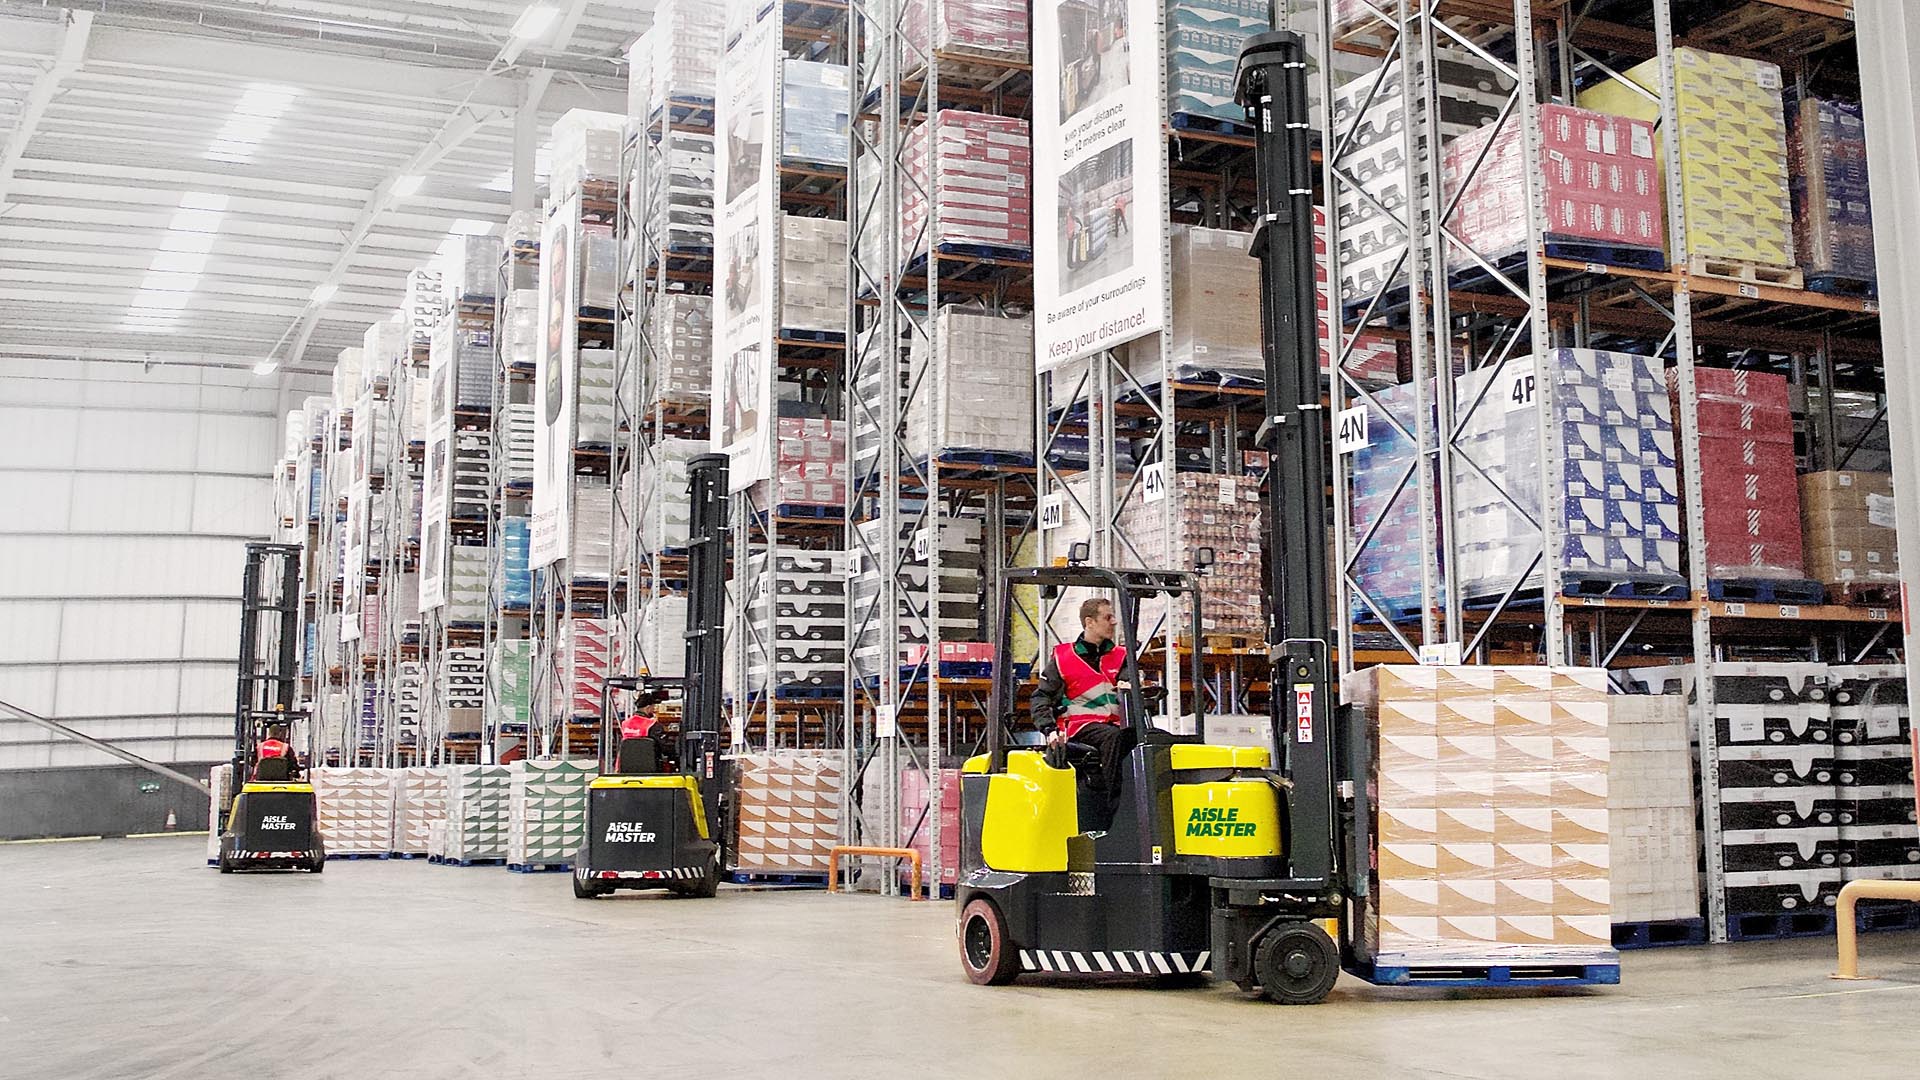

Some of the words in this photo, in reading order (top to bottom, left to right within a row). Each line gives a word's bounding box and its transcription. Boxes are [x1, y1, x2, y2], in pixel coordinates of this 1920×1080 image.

[1078, 121, 1093, 137] your
[1094, 103, 1124, 125] distance
[1083, 128, 1106, 148] metres
[1107, 118, 1127, 135] clear
[1047, 312, 1056, 324] Be
[1057, 305, 1077, 320] aware
[1077, 298, 1085, 312] of
[1085, 294, 1100, 311] your
[1101, 276, 1147, 303] surroundings
[1048, 338, 1073, 359] Keep
[1074, 330, 1097, 352] your
[1099, 307, 1147, 340] distance!
[1511, 375, 1535, 405] 4P
[1339, 412, 1364, 444] 4N
[1042, 504, 1060, 525] 4M
[1725, 605, 1732, 614] A
[1780, 607, 1787, 617] C
[605, 832, 656, 843] MASTER
[1186, 823, 1257, 837] MASTER
